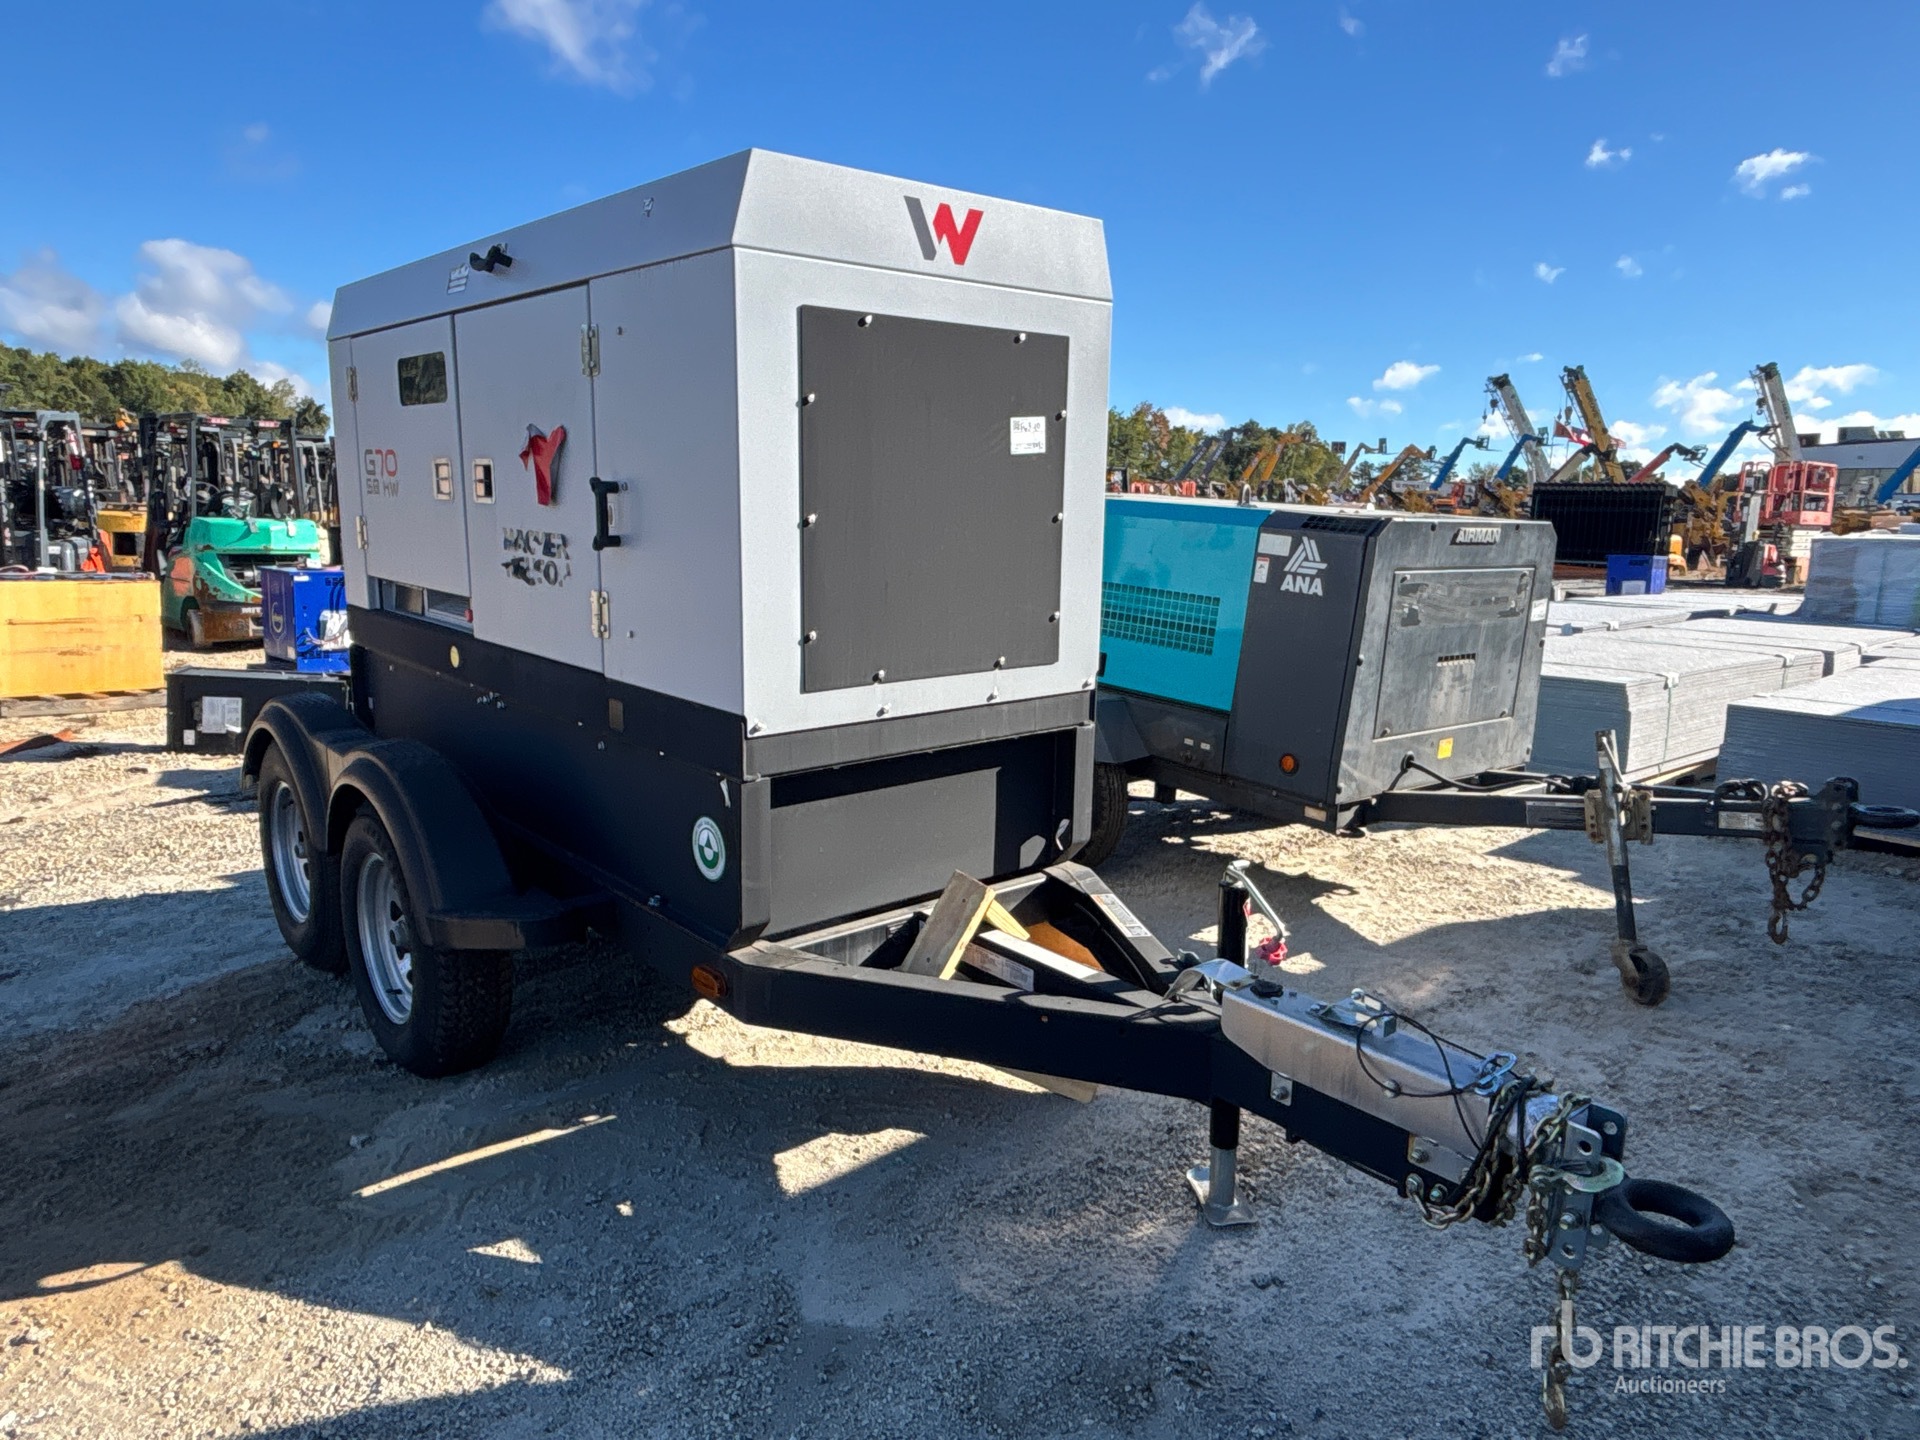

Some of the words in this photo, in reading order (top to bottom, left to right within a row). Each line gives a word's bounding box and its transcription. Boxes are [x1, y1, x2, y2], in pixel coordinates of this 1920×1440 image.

[364, 449, 398, 478] G70
[1455, 527, 1502, 543] AIRMAN
[1280, 574, 1323, 597] ANA
